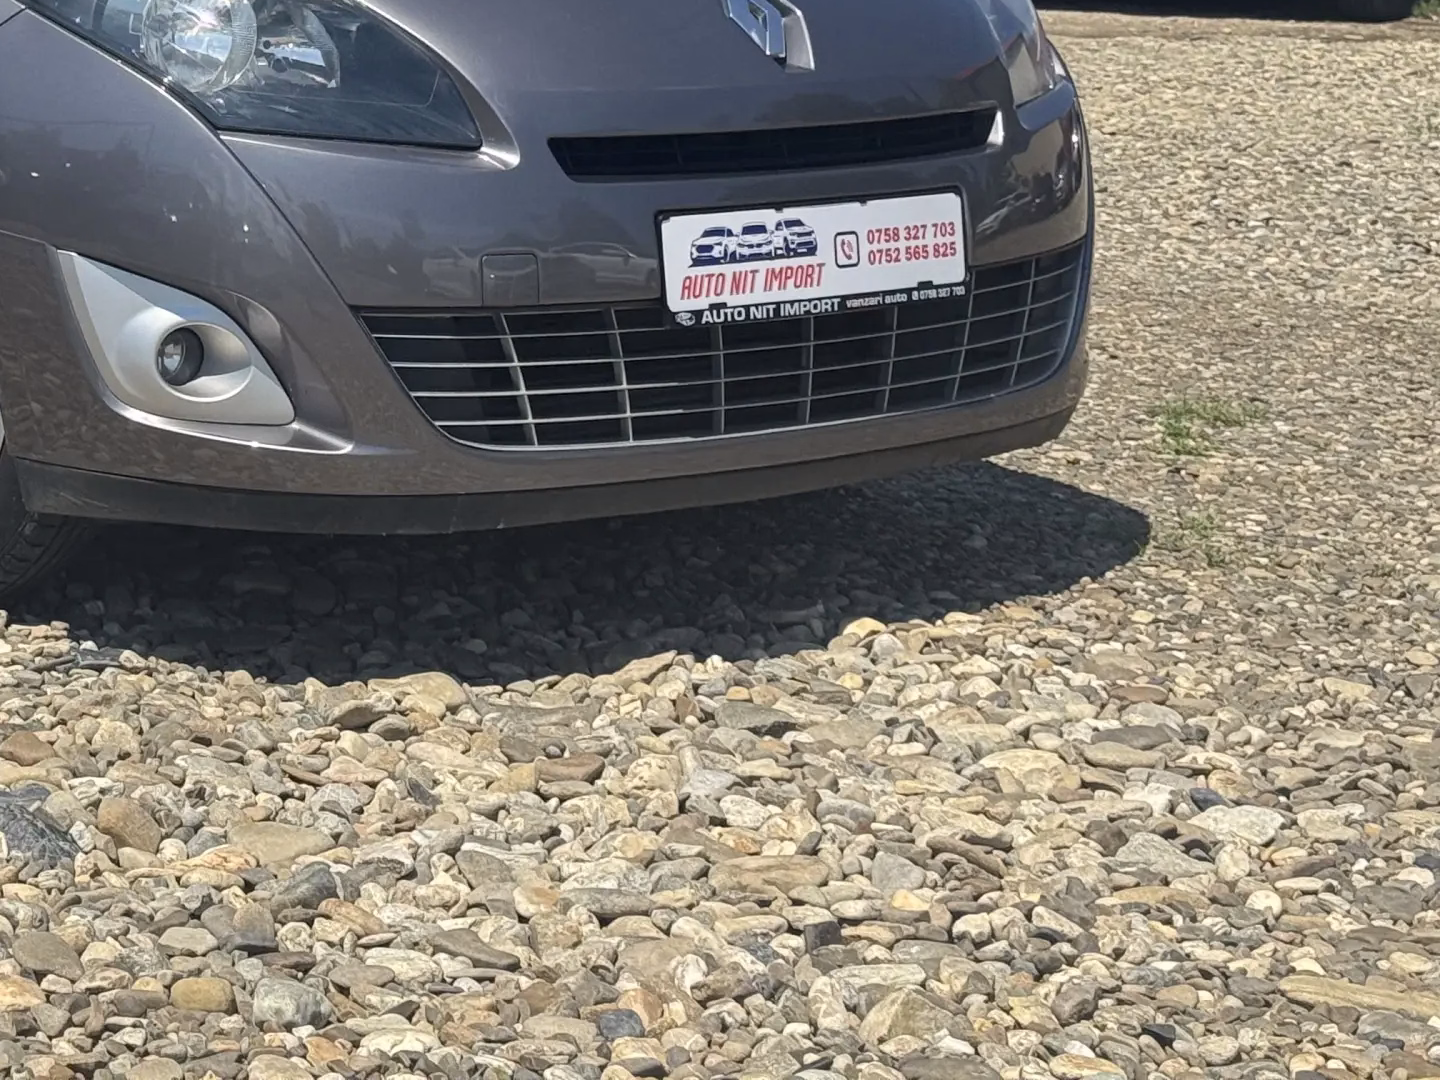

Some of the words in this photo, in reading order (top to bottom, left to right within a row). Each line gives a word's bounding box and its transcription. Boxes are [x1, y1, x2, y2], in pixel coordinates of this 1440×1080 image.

[866, 226, 900, 245] 0758
[904, 224, 927, 241] 327
[931, 221, 956, 238] 703
[868, 247, 901, 266] 0752
[905, 244, 929, 261] 565
[933, 241, 957, 258] 825
[680, 273, 726, 300] AUTO
[730, 269, 760, 296] NIT
[763, 262, 826, 292] IMPORT
[701, 306, 746, 324] AUTO
[749, 304, 777, 320] NIT
[780, 297, 841, 317] IMPORT
[885, 293, 907, 304] auto
